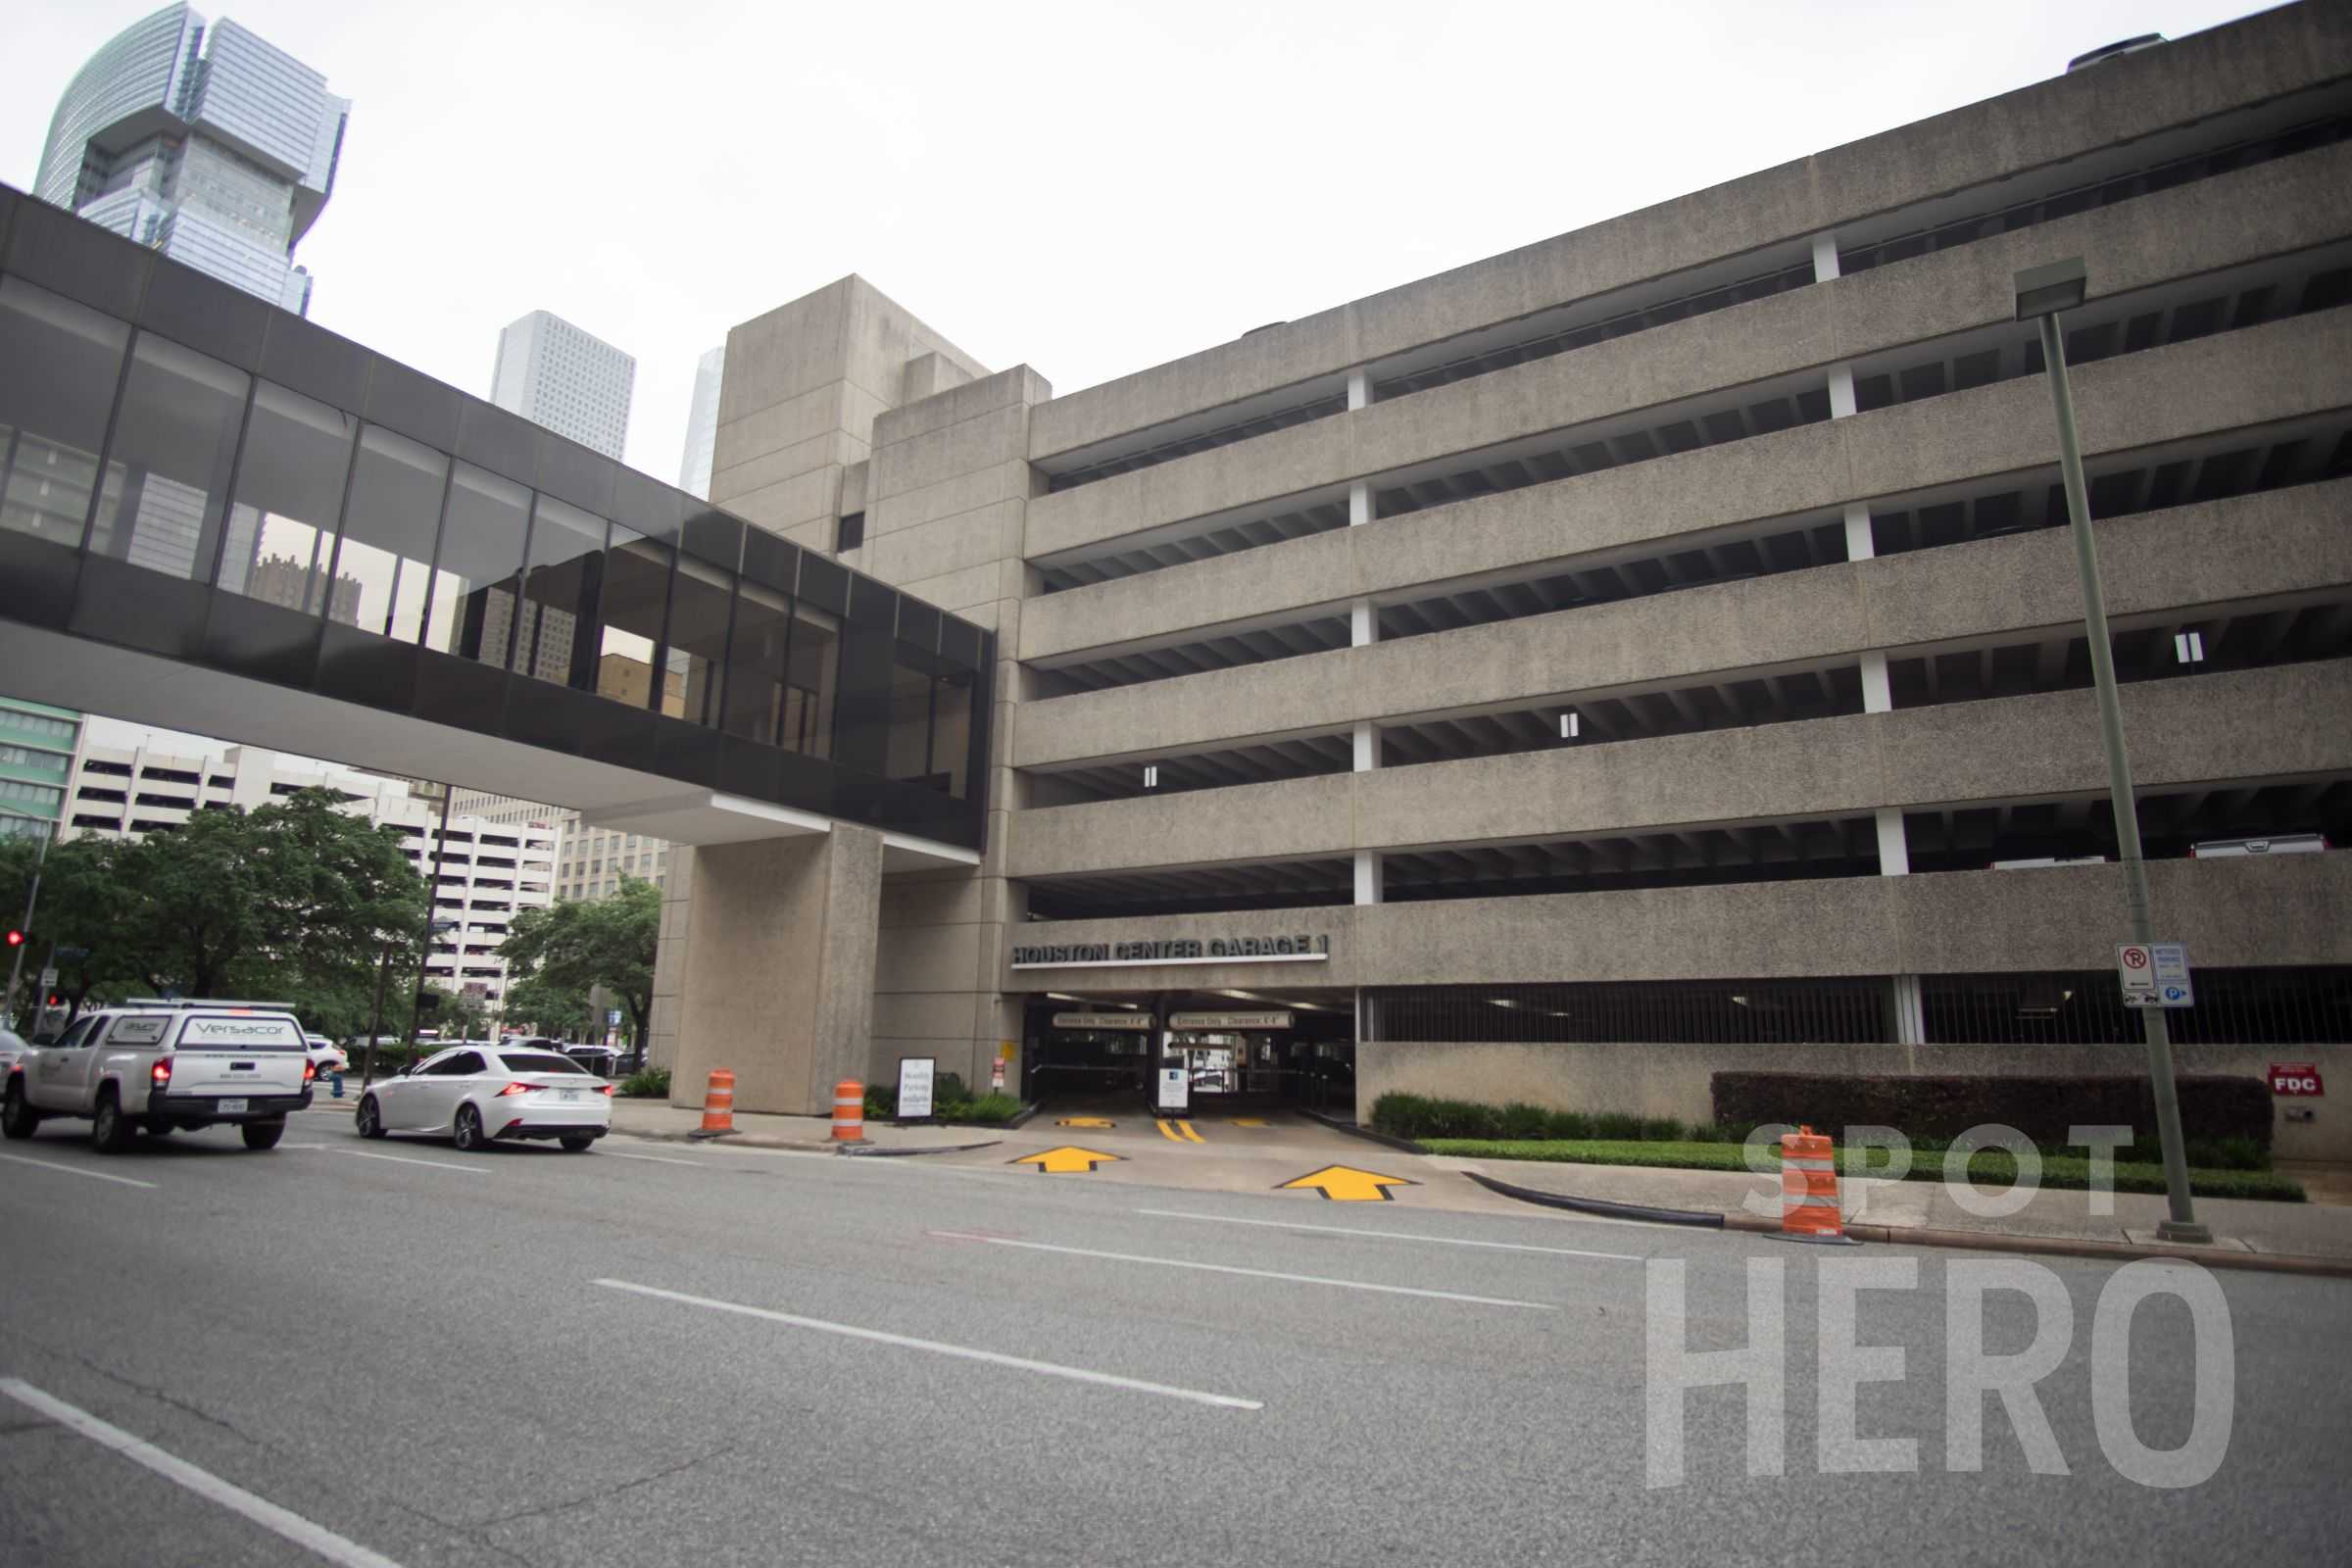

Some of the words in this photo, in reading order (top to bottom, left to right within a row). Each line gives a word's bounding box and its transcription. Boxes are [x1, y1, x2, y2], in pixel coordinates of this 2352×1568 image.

[1011, 943, 1108, 964] HOUSTON
[1113, 939, 1201, 959] CENTER
[1207, 935, 1311, 957] GARAGE
[1318, 934, 1329, 955] 1
[2275, 1077, 2316, 1091] FDC
